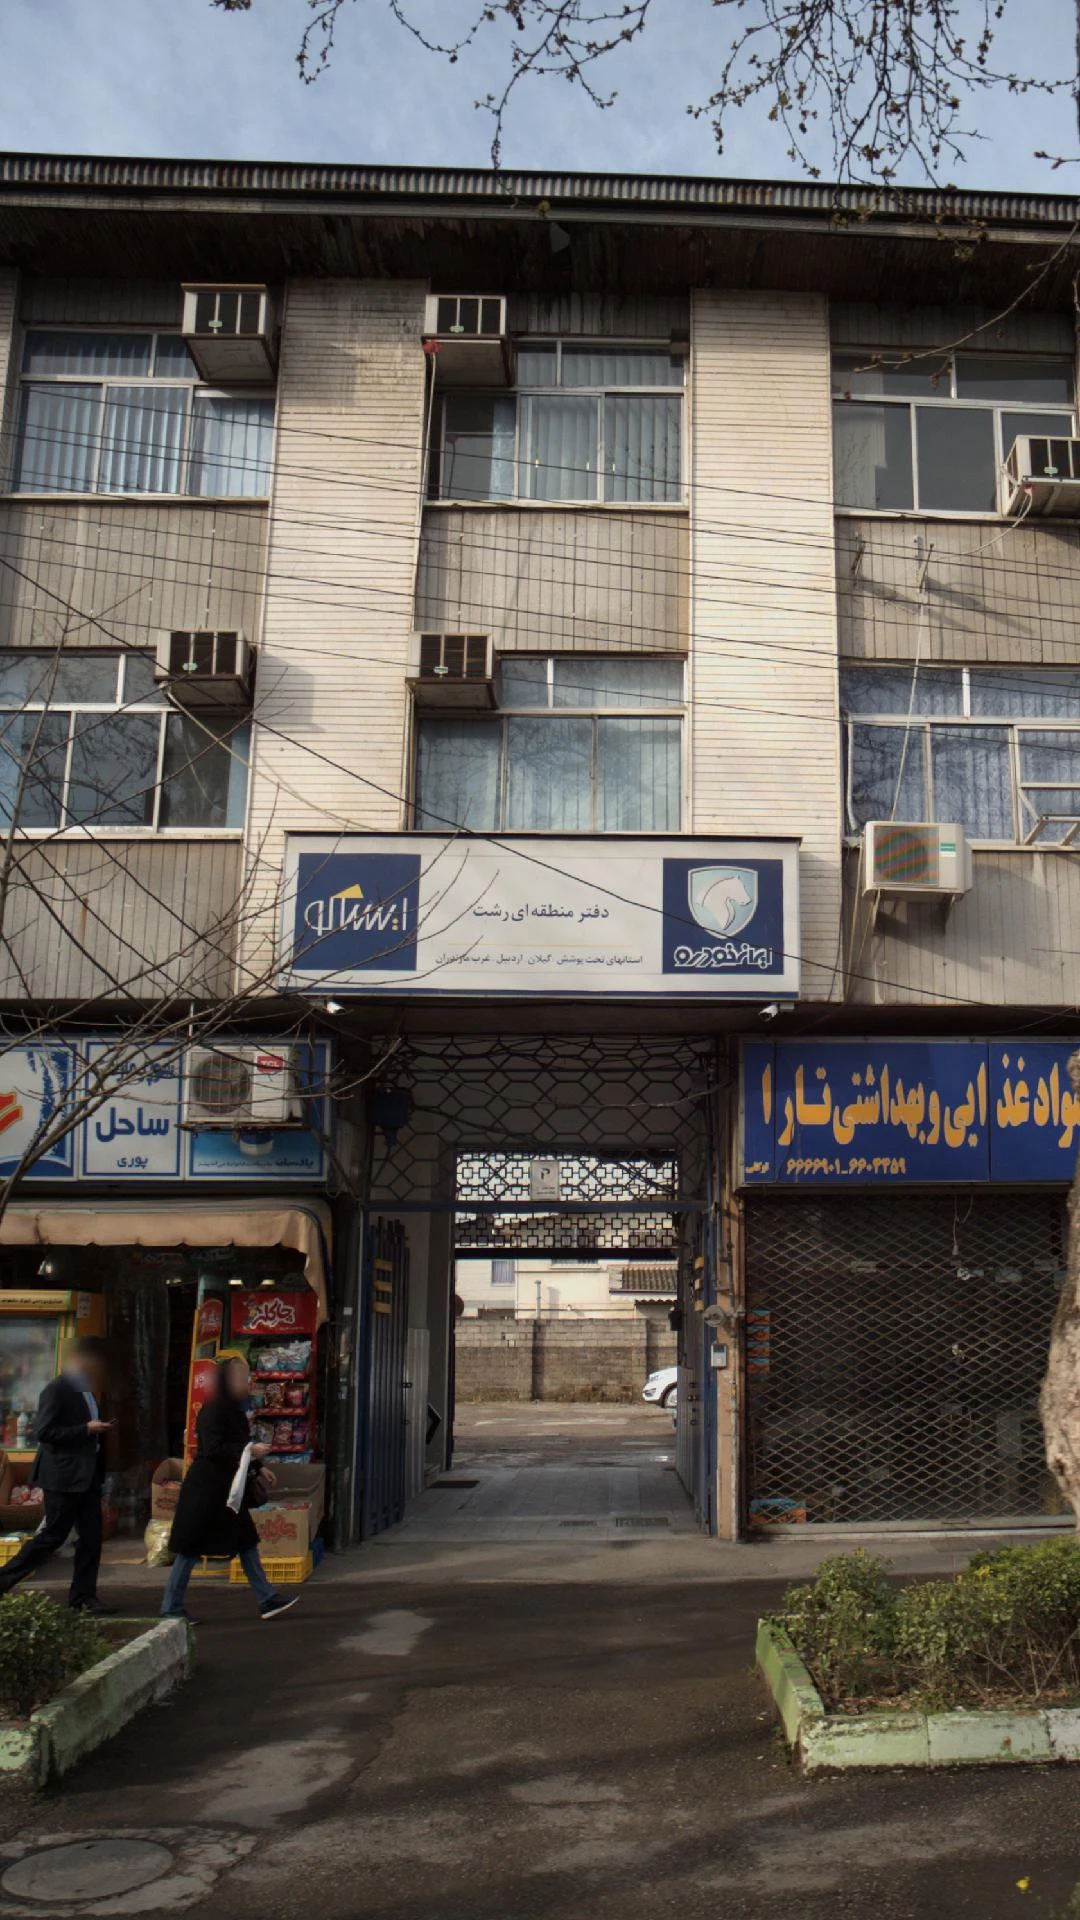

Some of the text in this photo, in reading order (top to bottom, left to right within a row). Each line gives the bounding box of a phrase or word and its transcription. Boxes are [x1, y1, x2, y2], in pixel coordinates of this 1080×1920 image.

[473, 904, 609, 922] دفتر منطقه ای رشت
[471, 954, 490, 965] غرب
[496, 953, 523, 965] اردبیل
[527, 953, 553, 965] گیلان
[556, 954, 584, 966] پوشش
[585, 954, 605, 964] تحت
[832, 1063, 926, 1146] بهداشتی
[944, 1052, 1030, 1148] غذایی
[95, 1106, 170, 1143] ساحل
[116, 1155, 149, 1169] پوری
